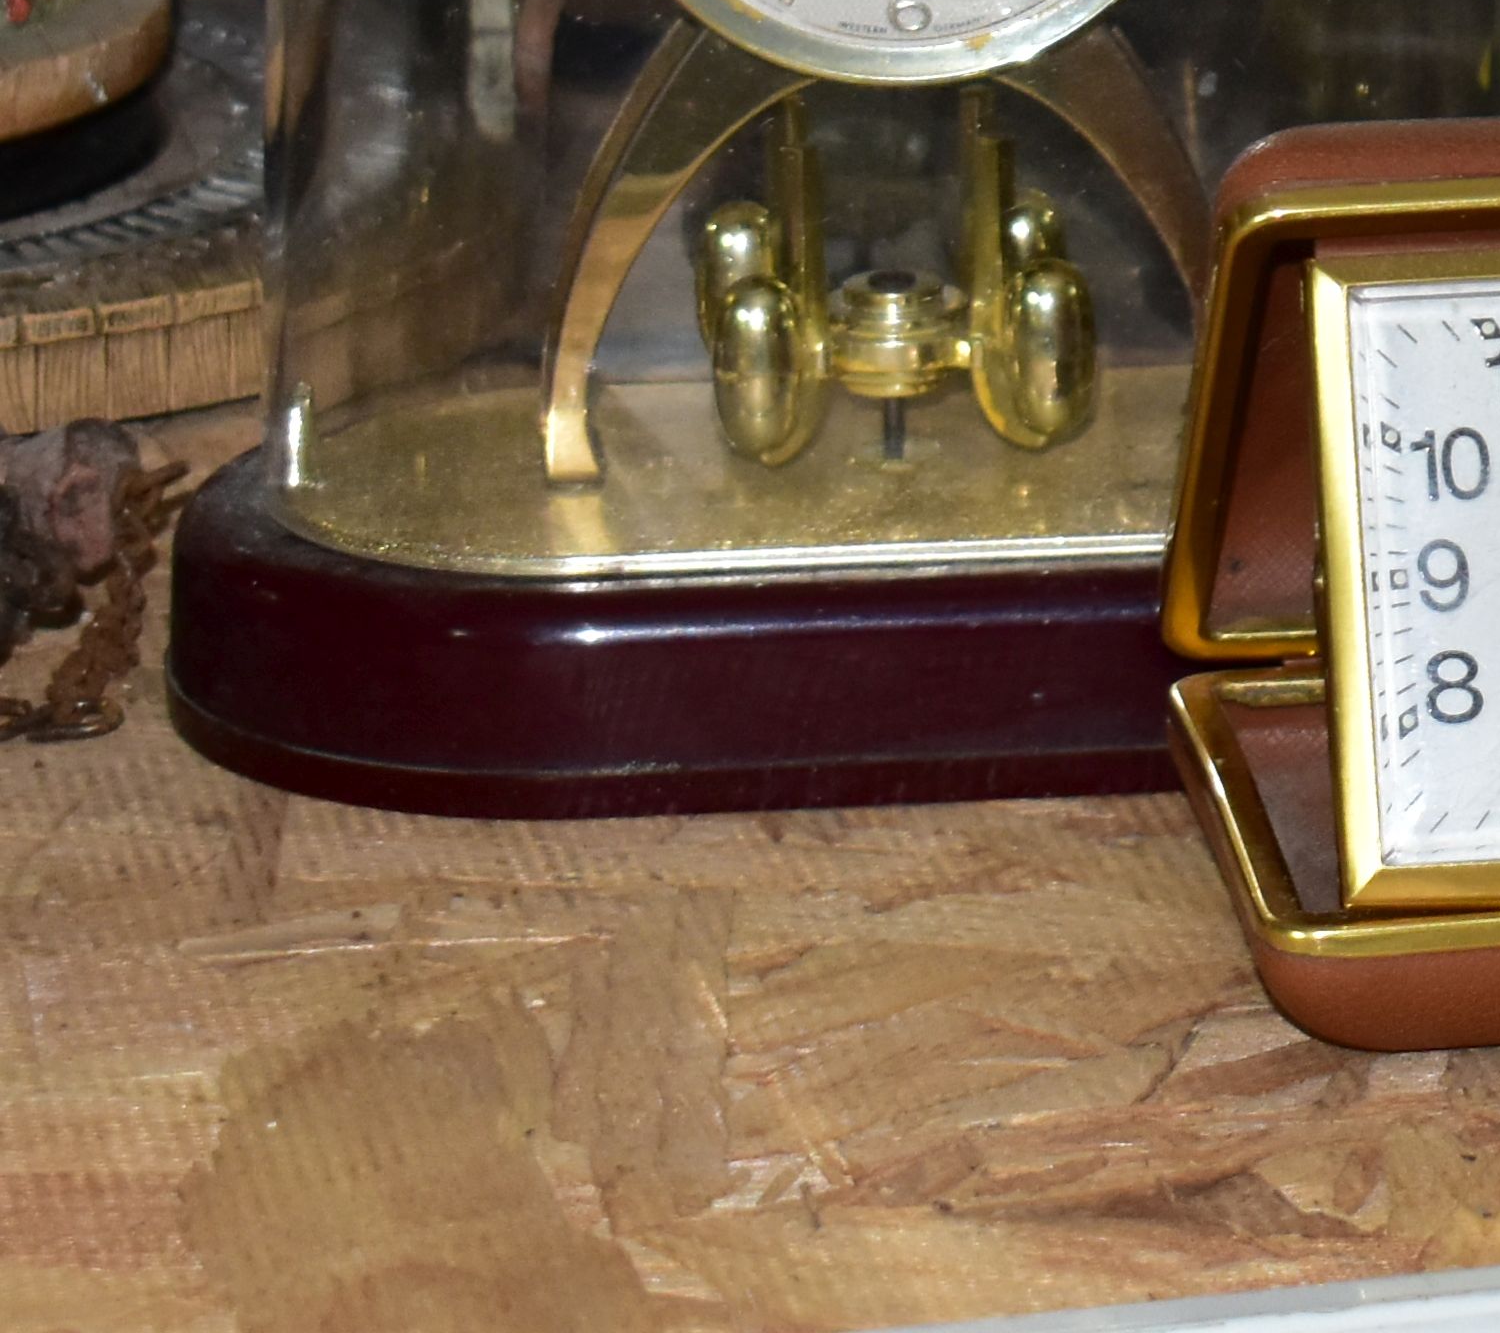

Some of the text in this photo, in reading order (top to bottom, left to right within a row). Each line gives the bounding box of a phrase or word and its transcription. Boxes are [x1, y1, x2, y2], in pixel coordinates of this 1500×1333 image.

[1410, 427, 1491, 502] 10
[1416, 538, 1470, 614] 9
[1426, 649, 1485, 725] 8
